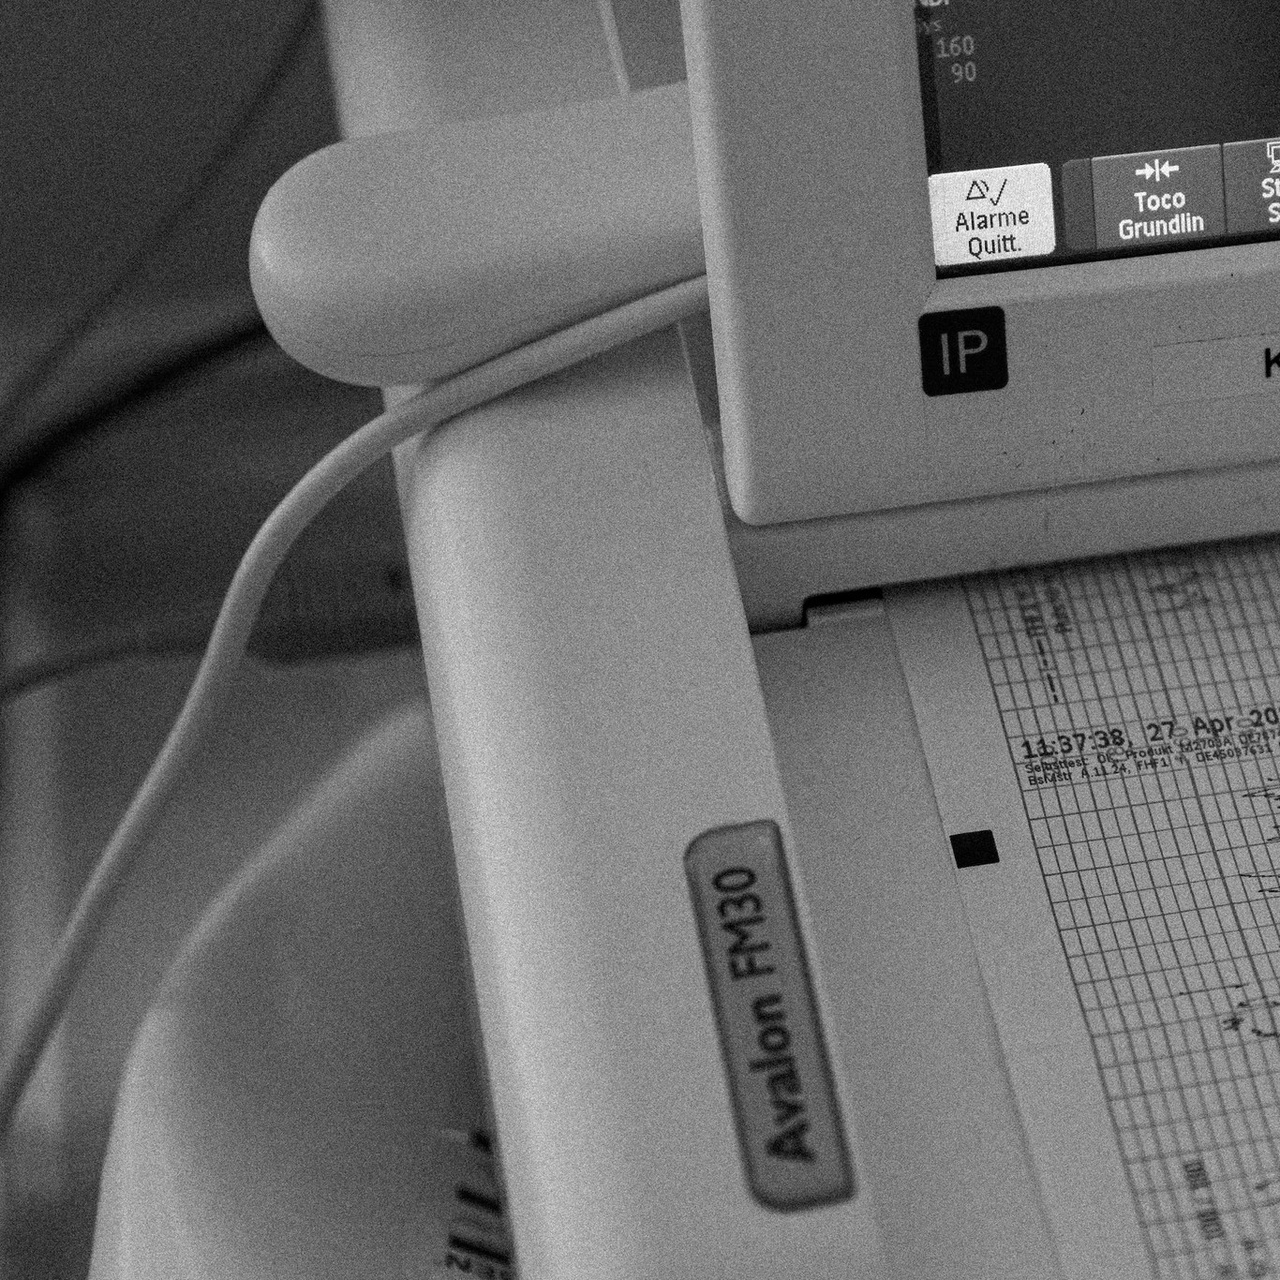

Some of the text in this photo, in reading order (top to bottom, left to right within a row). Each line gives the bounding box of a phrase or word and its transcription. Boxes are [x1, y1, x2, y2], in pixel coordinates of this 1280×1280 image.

[936, 35, 975, 59] 160
[951, 61, 977, 84] 90
[1134, 190, 1186, 213] Toco
[955, 209, 1030, 233] Alarme
[1118, 212, 1204, 241] Grundlin
[968, 233, 1022, 259] Quitt.
[940, 329, 989, 376] IP
[1021, 728, 1134, 760] 11:37:38,
[1147, 721, 1175, 743] 27
[1193, 715, 1234, 739] Apr
[1126, 741, 1174, 761] Produkt
[1136, 755, 1170, 773] FHF1
[711, 866, 817, 1165] Avalon FM30
